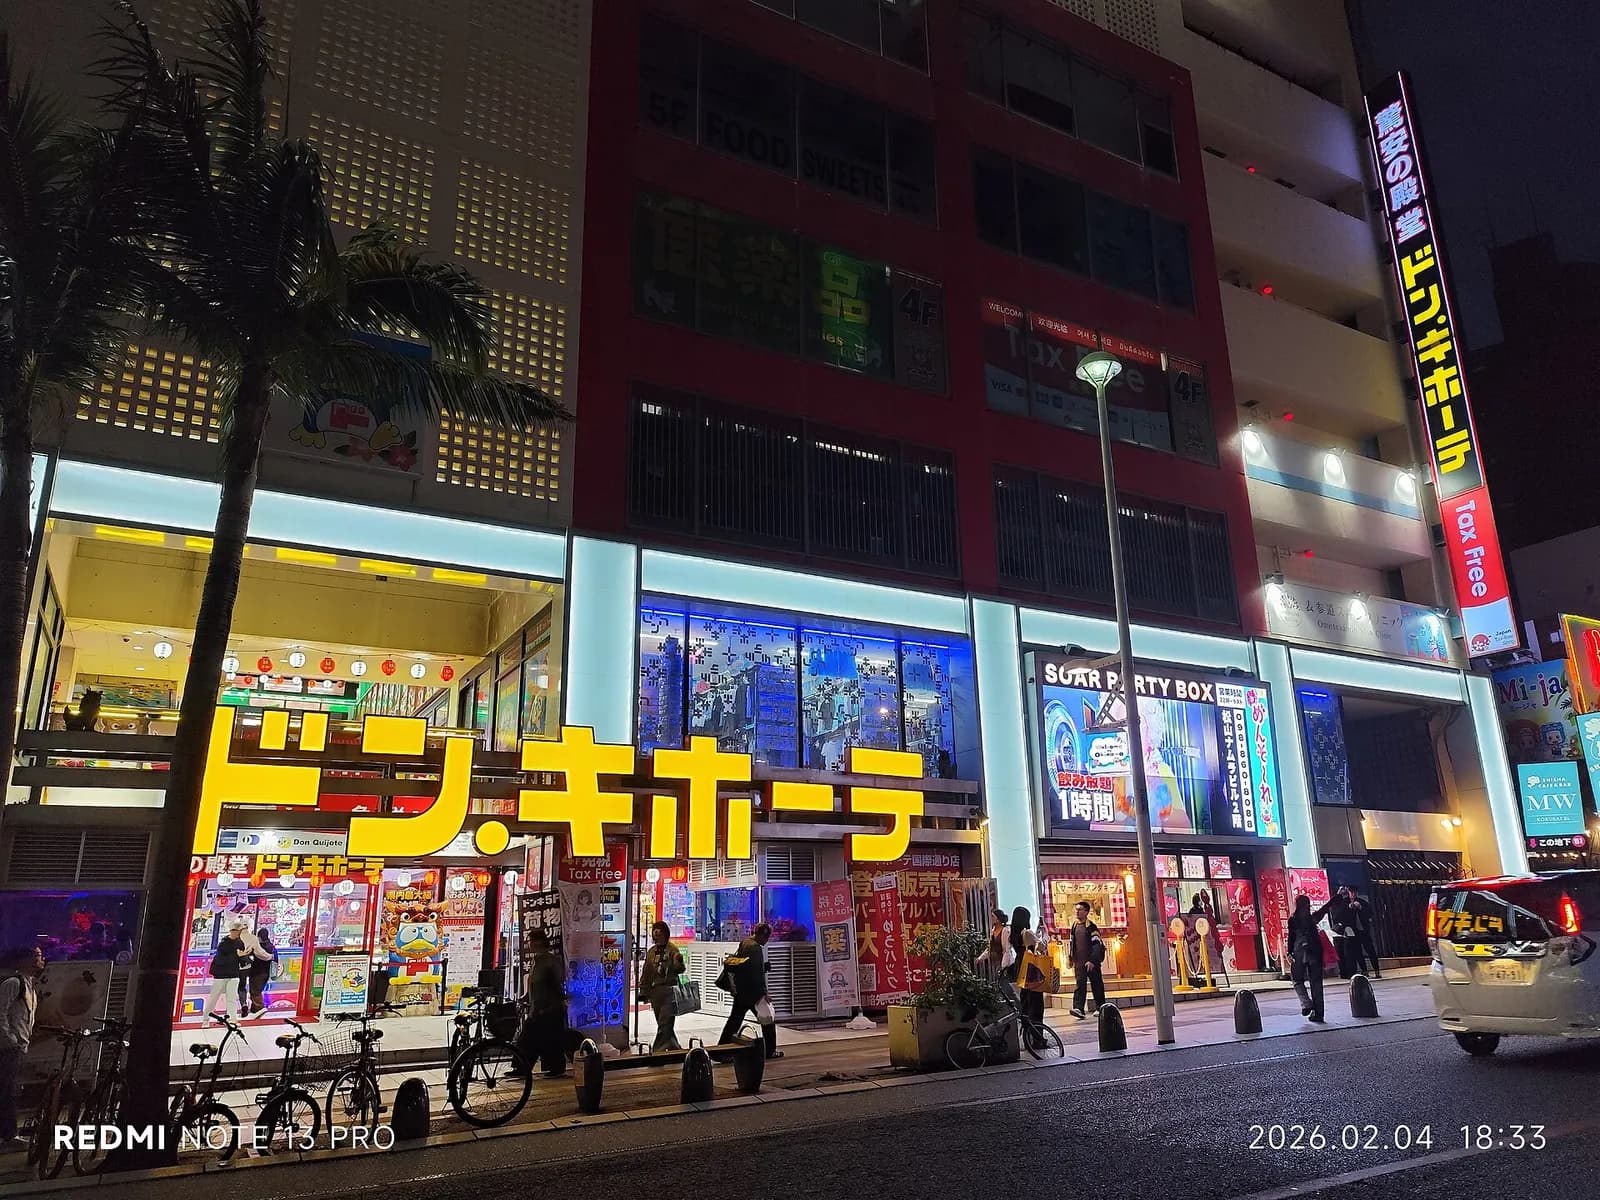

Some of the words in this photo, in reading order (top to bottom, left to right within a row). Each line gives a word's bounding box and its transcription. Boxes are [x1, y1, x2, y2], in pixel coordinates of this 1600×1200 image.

[706, 111, 790, 170] FOOD
[803, 147, 886, 204] SWEETS
[1374, 99, 1427, 244] 驚安の殿堂
[1455, 500, 1477, 544] Tax
[1464, 545, 1488, 598] Free
[1107, 671, 1171, 698] PRTY
[1175, 680, 1215, 702] BOX
[1497, 673, 1562, 707] Mi-ja
[1057, 773, 1112, 791] 飲み放題
[1058, 792, 1115, 822] 1時間
[1527, 794, 1576, 811] MW
[293, 838, 311, 848] Don
[312, 838, 343, 849] Quijote
[1539, 838, 1571, 848] この地下
[569, 867, 591, 880] Tax
[595, 867, 622, 880] Free
[523, 908, 561, 929] 荷物
[882, 919, 899, 989] ゆうパック
